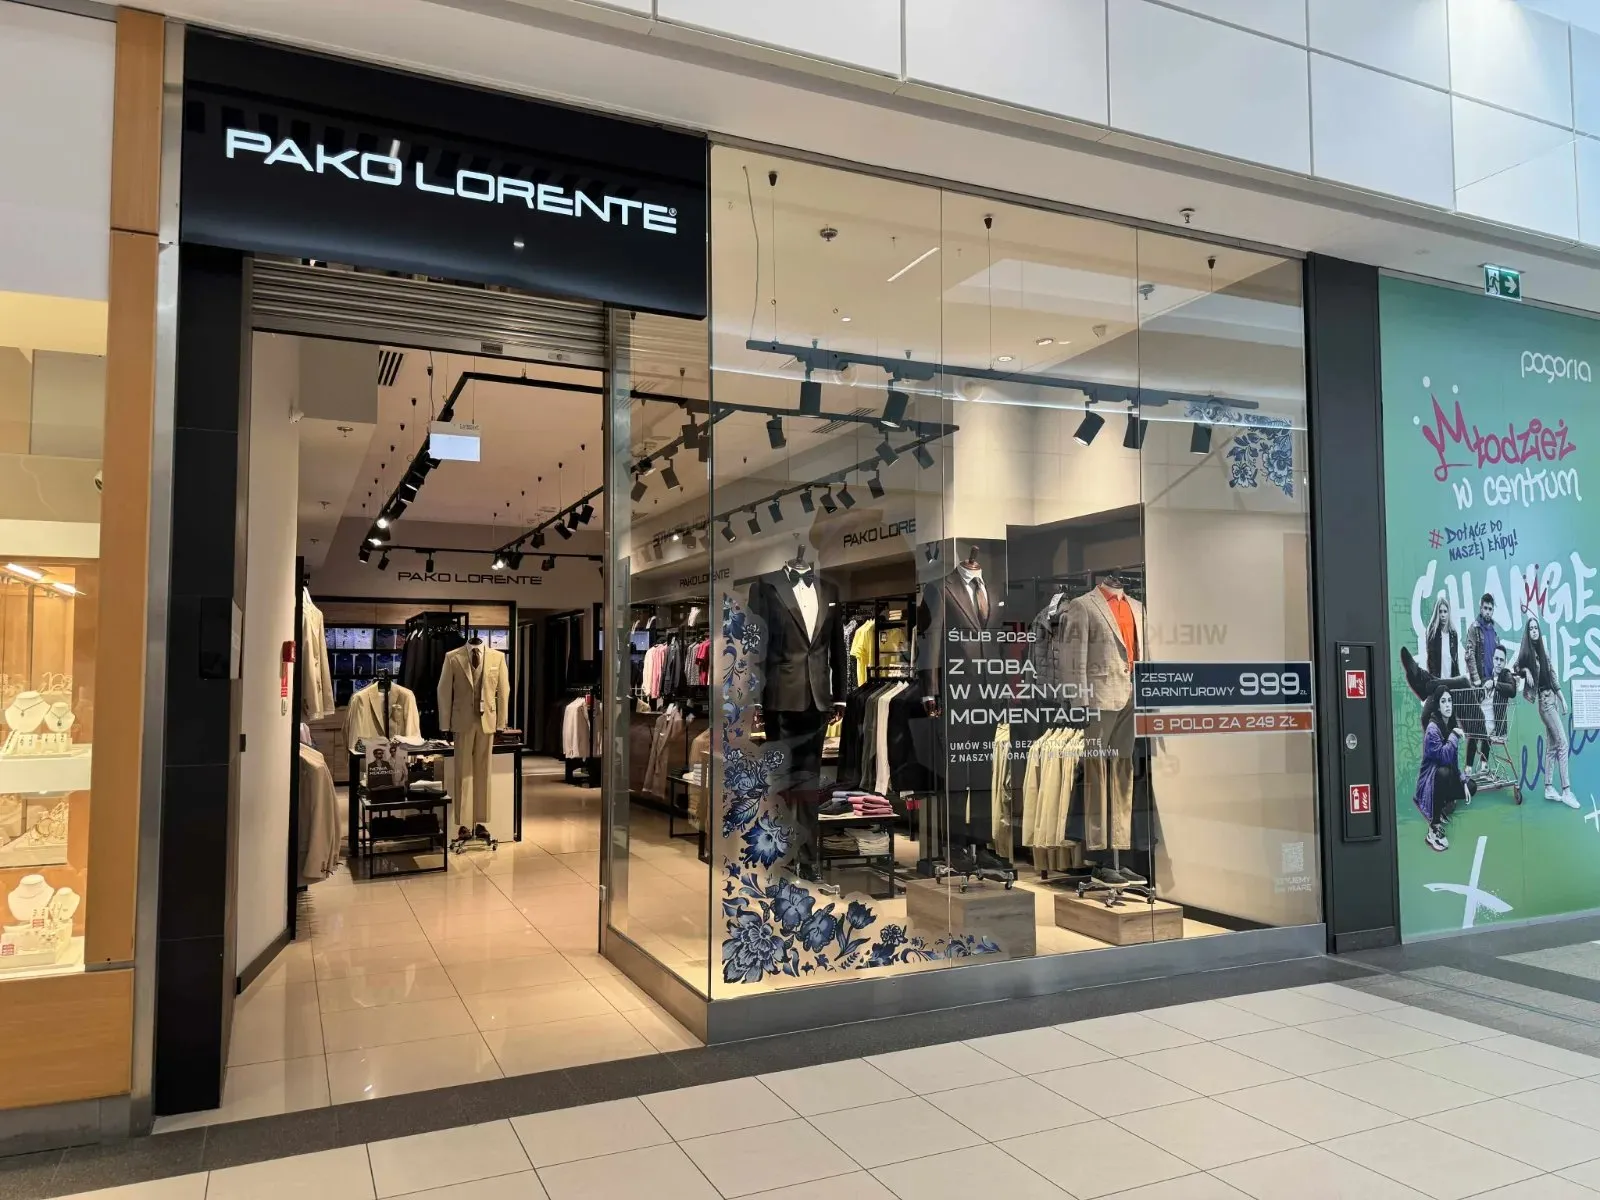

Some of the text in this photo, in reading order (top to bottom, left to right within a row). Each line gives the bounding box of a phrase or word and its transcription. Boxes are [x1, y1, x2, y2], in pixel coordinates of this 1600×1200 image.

[225, 128, 402, 186] PAKO
[1521, 350, 1592, 384] pogoria
[1422, 393, 1577, 482] Młodzież
[1483, 466, 1583, 508] centrum
[842, 518, 917, 549] PAKO LORE
[397, 571, 451, 583] PAKO
[679, 568, 730, 588] PAKO LOENTE
[1411, 551, 1600, 638] CHANGE
[948, 627, 992, 643] ŚLUB
[996, 631, 1037, 643] 2026
[949, 658, 965, 675] Z
[971, 658, 1038, 679] TOBĄ
[1141, 672, 1194, 683] ZESTAW
[949, 679, 1094, 700] W WAŻNYCH
[1141, 686, 1235, 697] GARNITUROWY
[1239, 672, 1300, 696] 999
[950, 707, 1101, 725] MOMENTACH
[1153, 714, 1299, 731] 3 POLO ZA 249 ZŁ
[950, 740, 980, 751] UMÓW
[950, 754, 957, 763] Z
